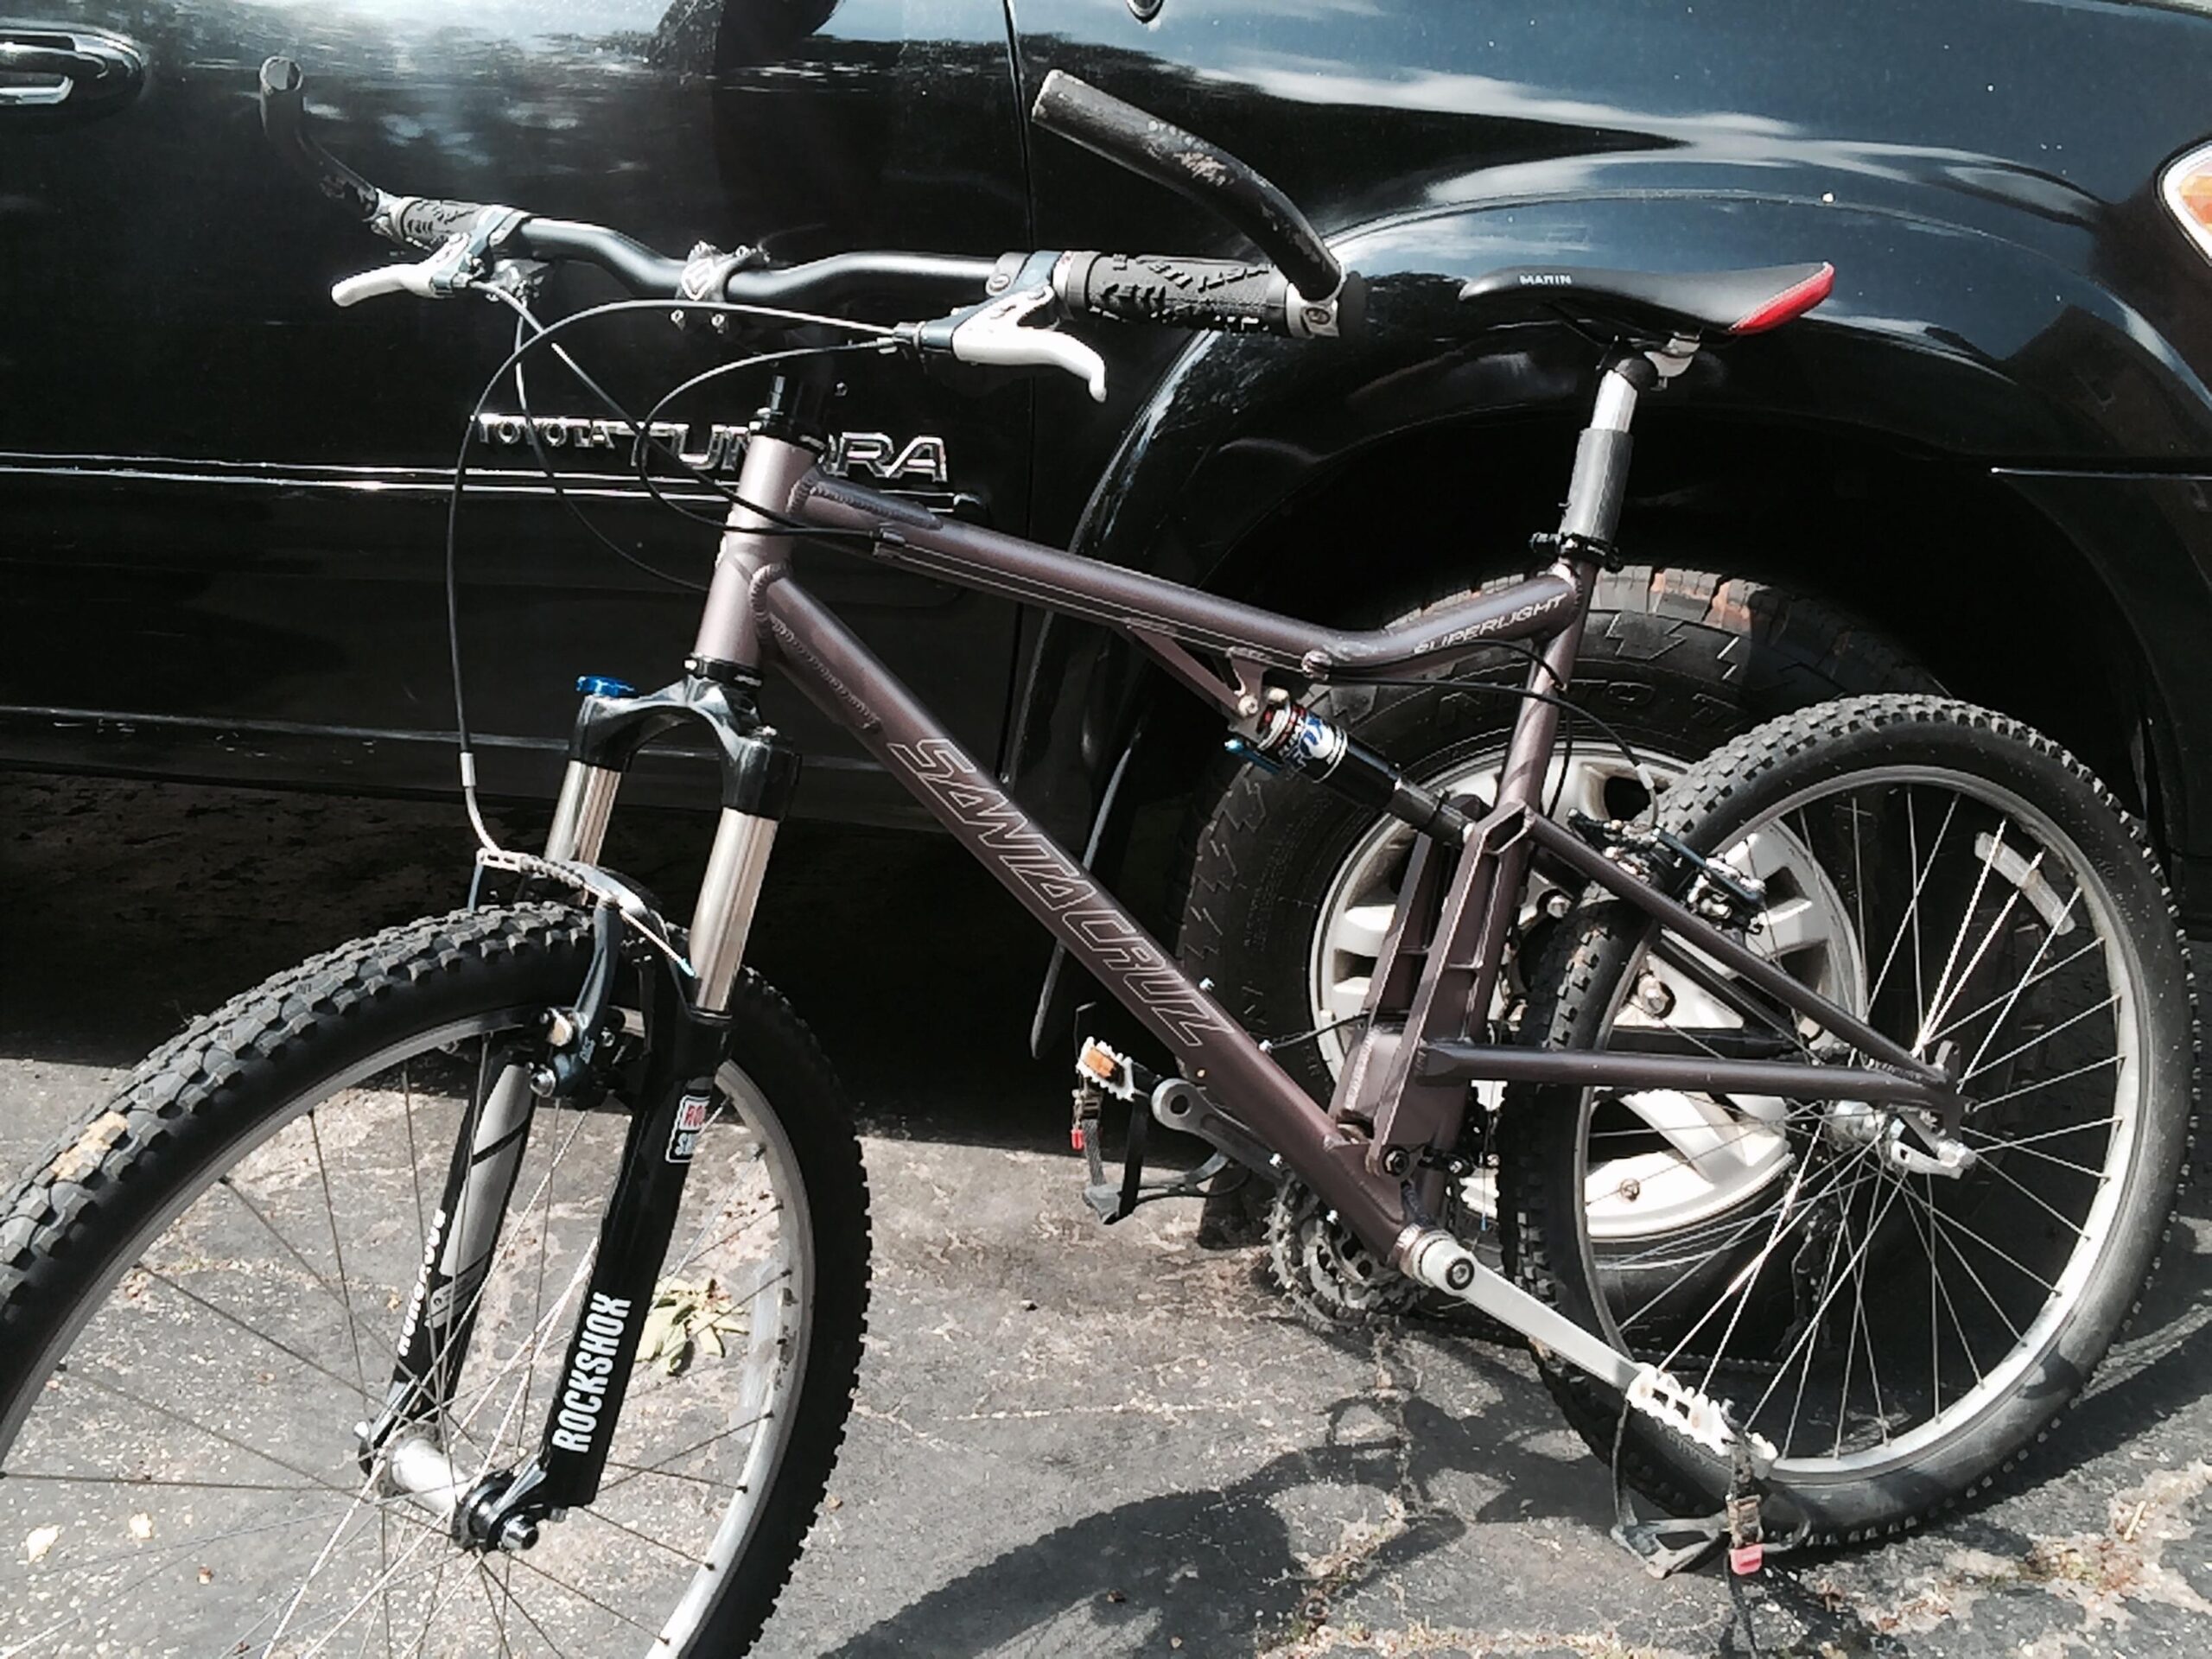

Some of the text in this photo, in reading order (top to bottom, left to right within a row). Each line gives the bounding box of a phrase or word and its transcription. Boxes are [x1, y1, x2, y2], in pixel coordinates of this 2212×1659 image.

[887, 738, 1099, 911] SANTA
[1063, 910, 1236, 1046] CRUZ
[551, 1292, 632, 1453] ROCKSHOX
